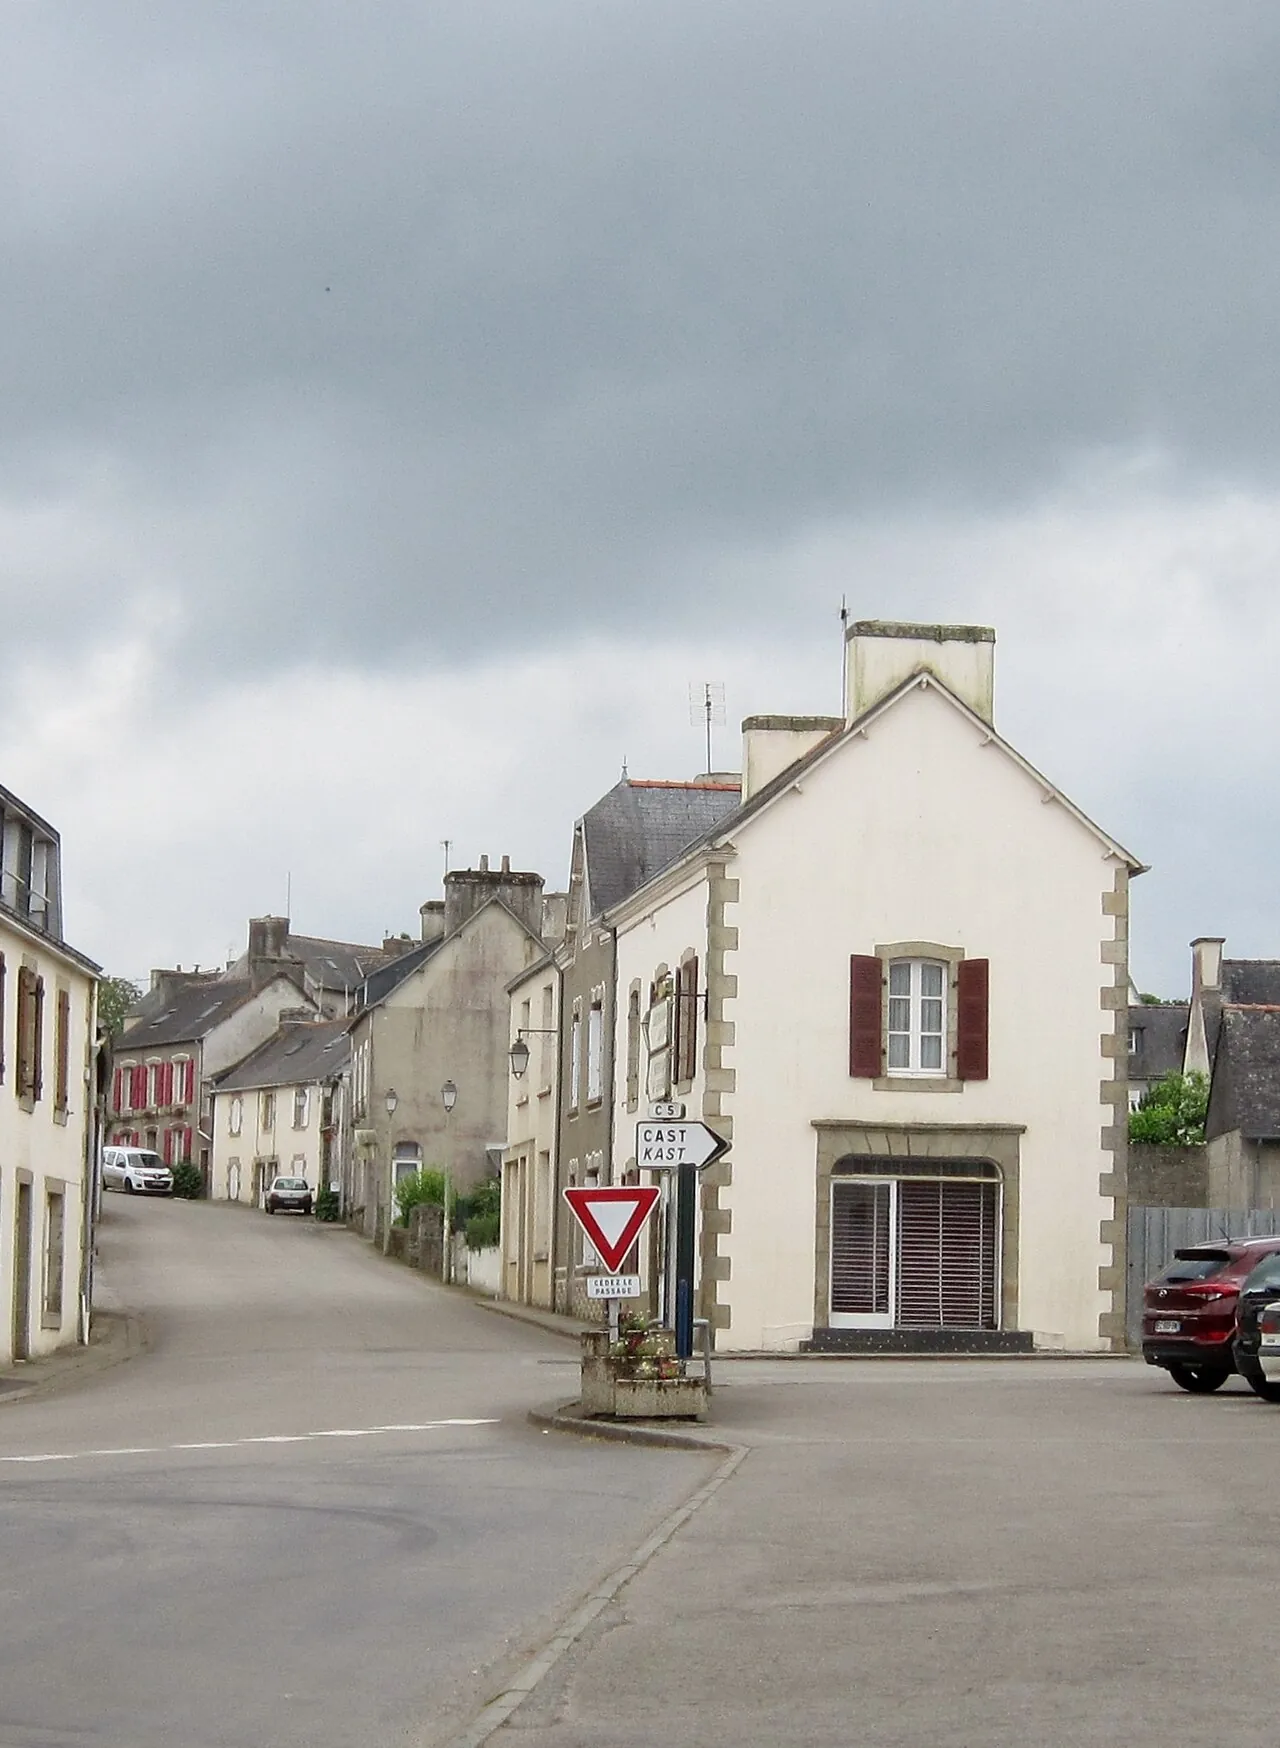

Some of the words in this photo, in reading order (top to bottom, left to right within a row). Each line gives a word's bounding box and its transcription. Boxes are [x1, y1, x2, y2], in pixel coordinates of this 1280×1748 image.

[655, 1105, 662, 1116] C
[667, 1105, 675, 1116] 5
[643, 1129, 687, 1143] CAST
[643, 1147, 686, 1161] KAST
[623, 1278, 633, 1286] LE
[595, 1287, 632, 1295] PASSAGE
